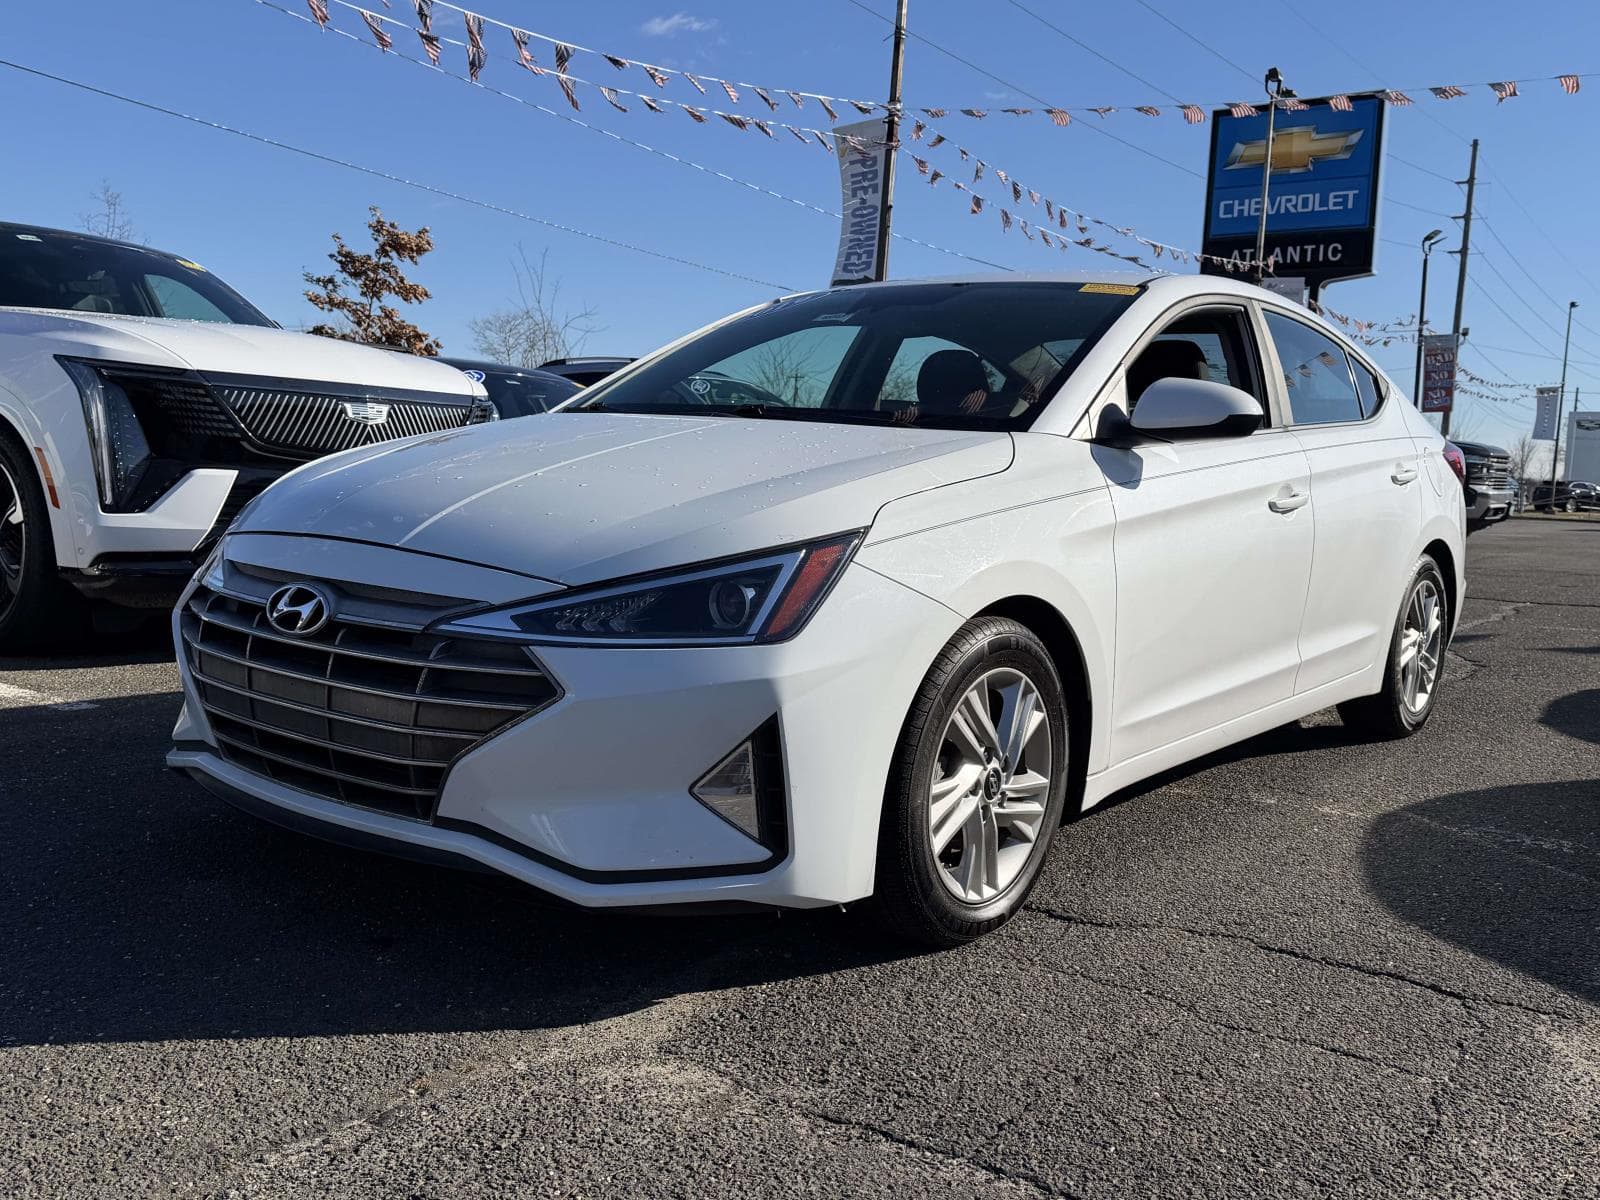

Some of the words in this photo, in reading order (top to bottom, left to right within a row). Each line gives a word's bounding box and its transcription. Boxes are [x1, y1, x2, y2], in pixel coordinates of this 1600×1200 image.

[842, 154, 879, 275] PRE-OWNED
[1218, 189, 1359, 219] CHEVROLET
[1230, 242, 1343, 265] ATANTIC
